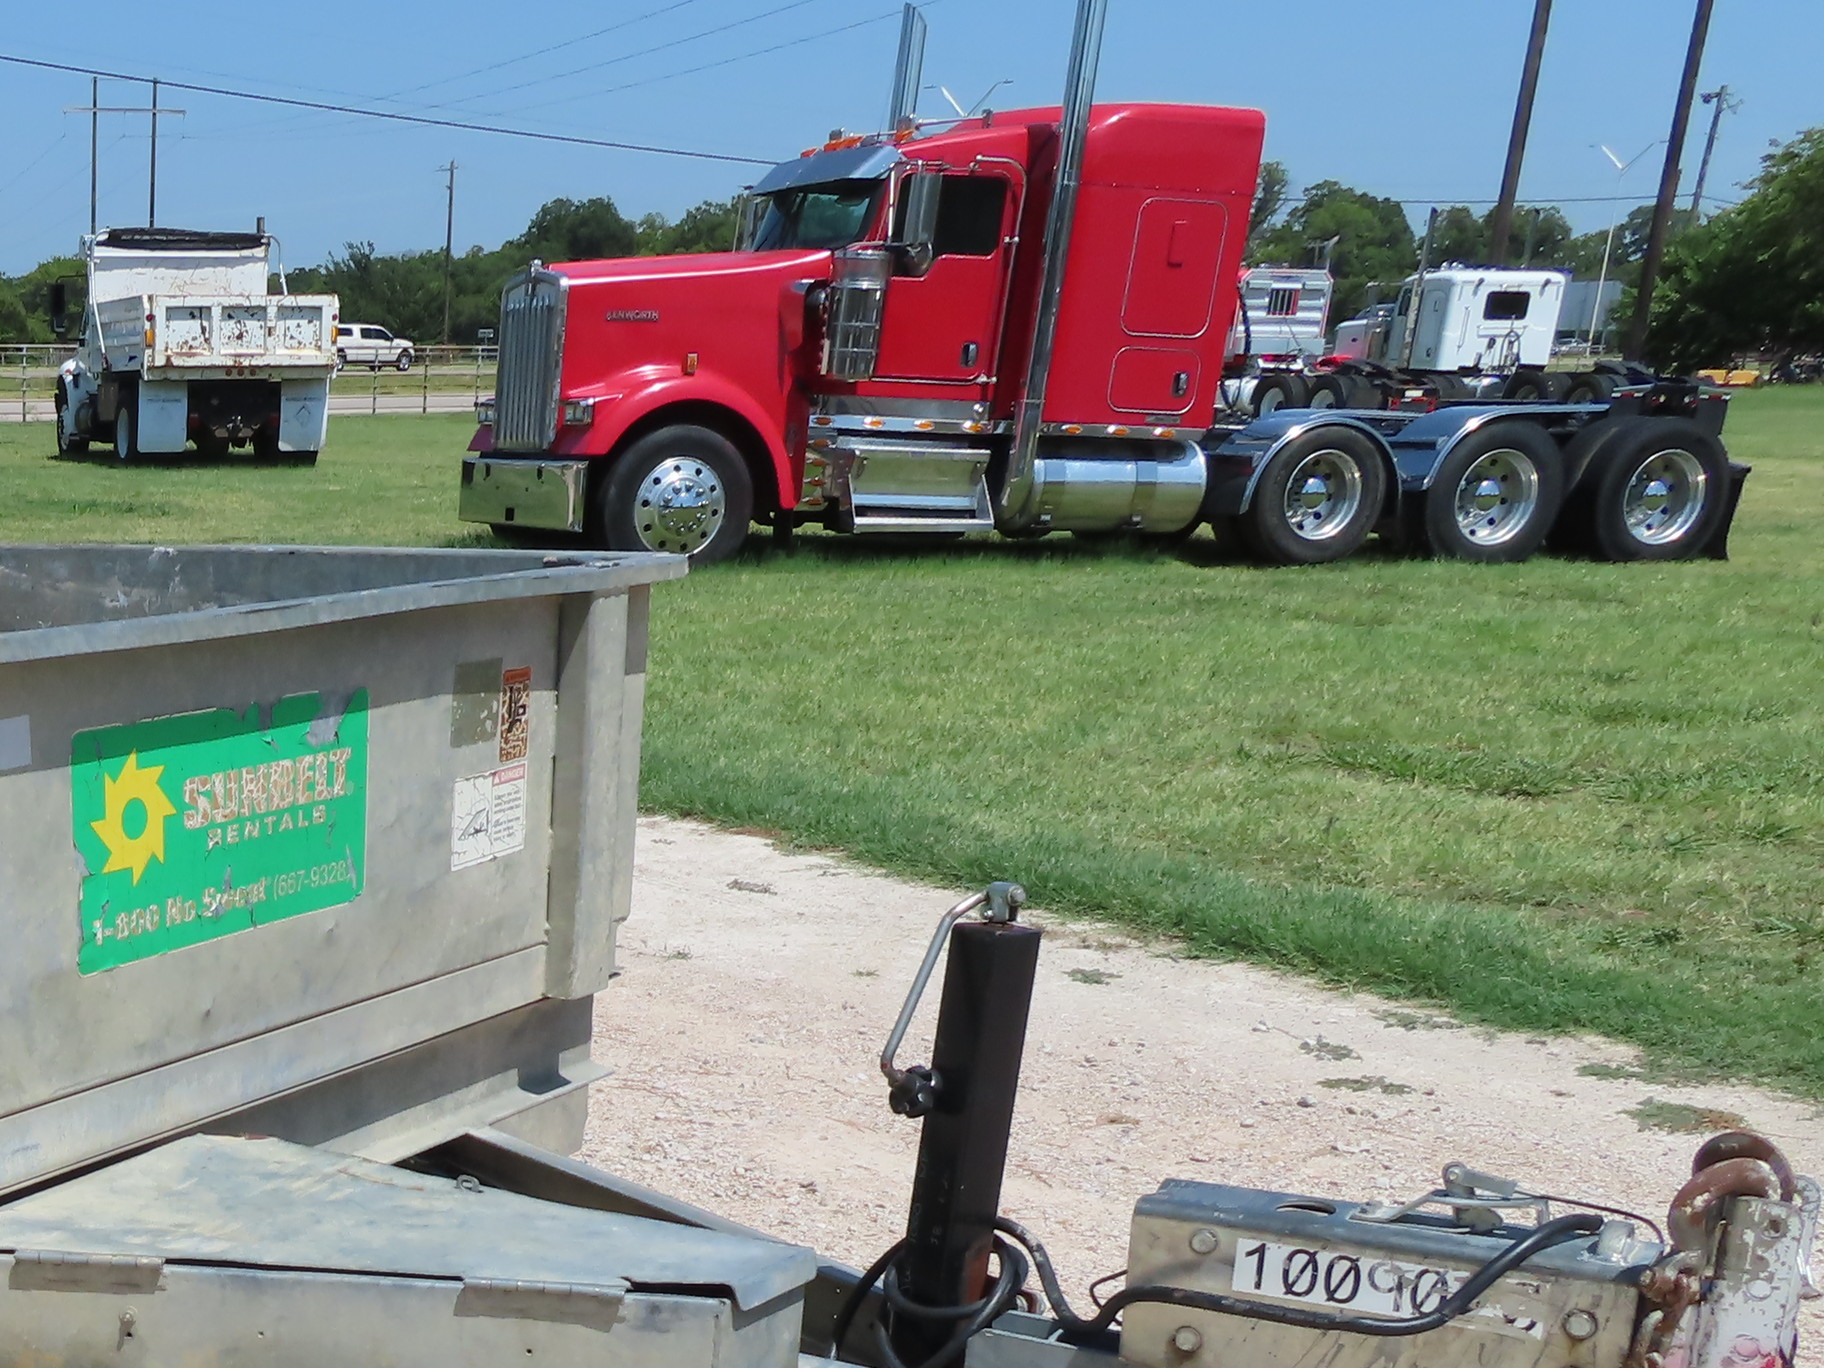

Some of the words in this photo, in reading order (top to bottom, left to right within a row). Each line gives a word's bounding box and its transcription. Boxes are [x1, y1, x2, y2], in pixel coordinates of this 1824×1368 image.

[183, 747, 352, 830] SUNBELT
[207, 804, 326, 850] RENTALS
[166, 895, 197, 927] No
